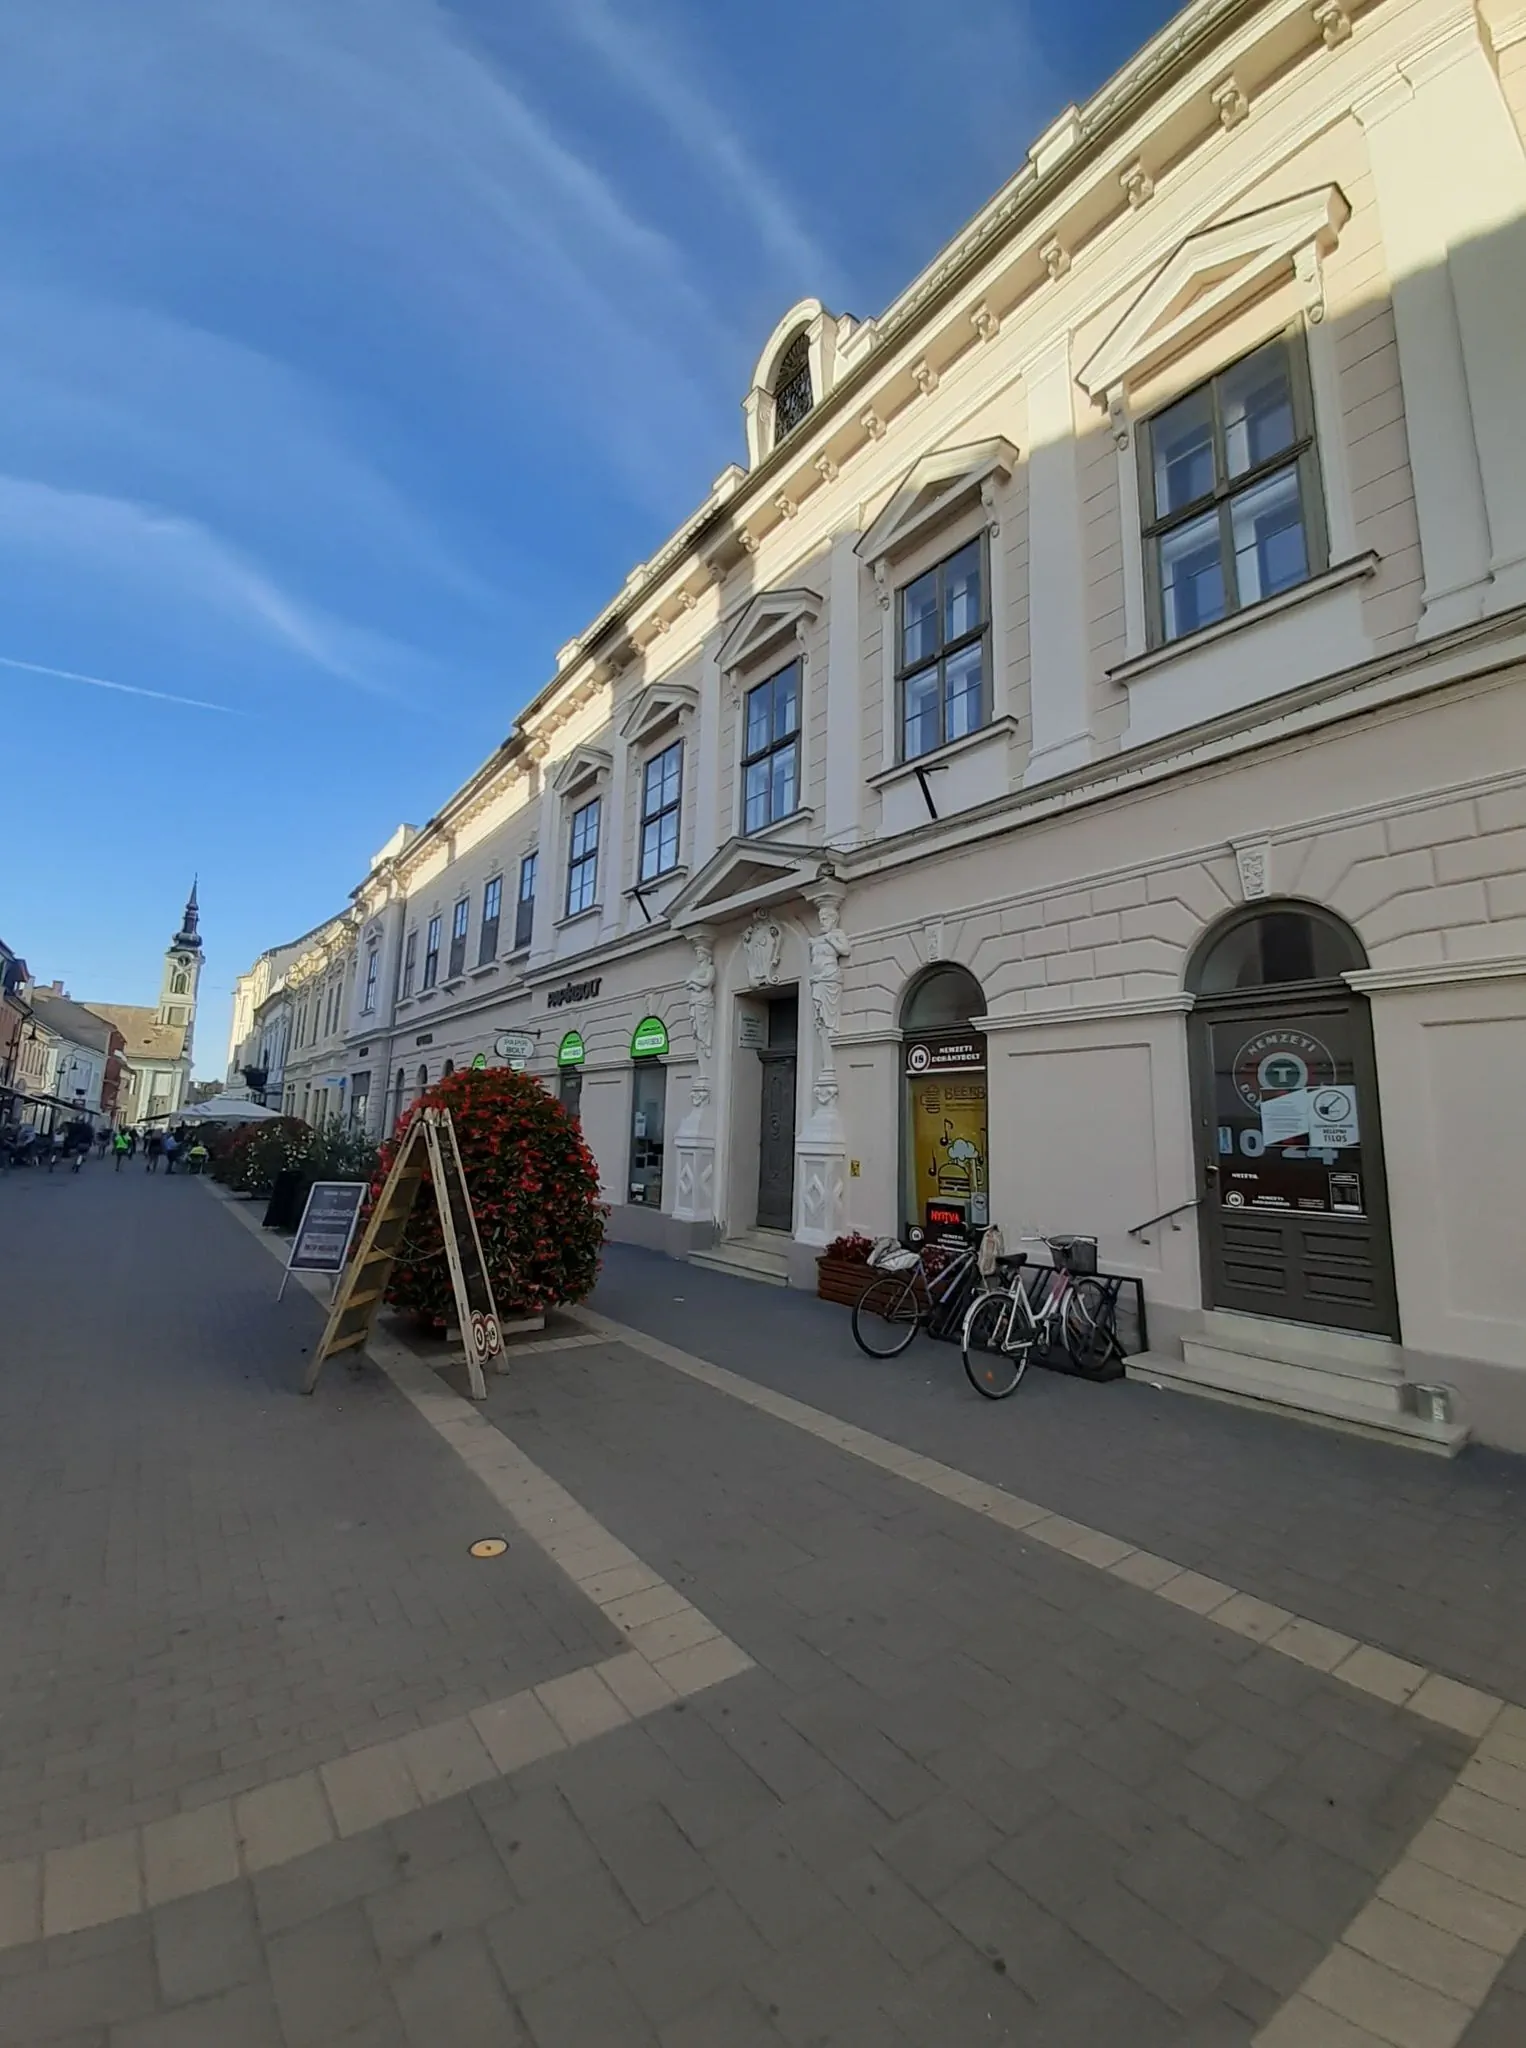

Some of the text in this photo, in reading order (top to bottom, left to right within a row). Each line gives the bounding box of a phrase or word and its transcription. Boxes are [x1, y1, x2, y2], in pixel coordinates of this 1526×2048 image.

[939, 1045, 972, 1053] NEMZETI
[1247, 1033, 1317, 1056] NEMZETI
[506, 1046, 525, 1054] BOLT
[914, 1055, 924, 1064] 18
[1272, 1067, 1292, 1083] T
[1323, 1134, 1348, 1143] TILOS
